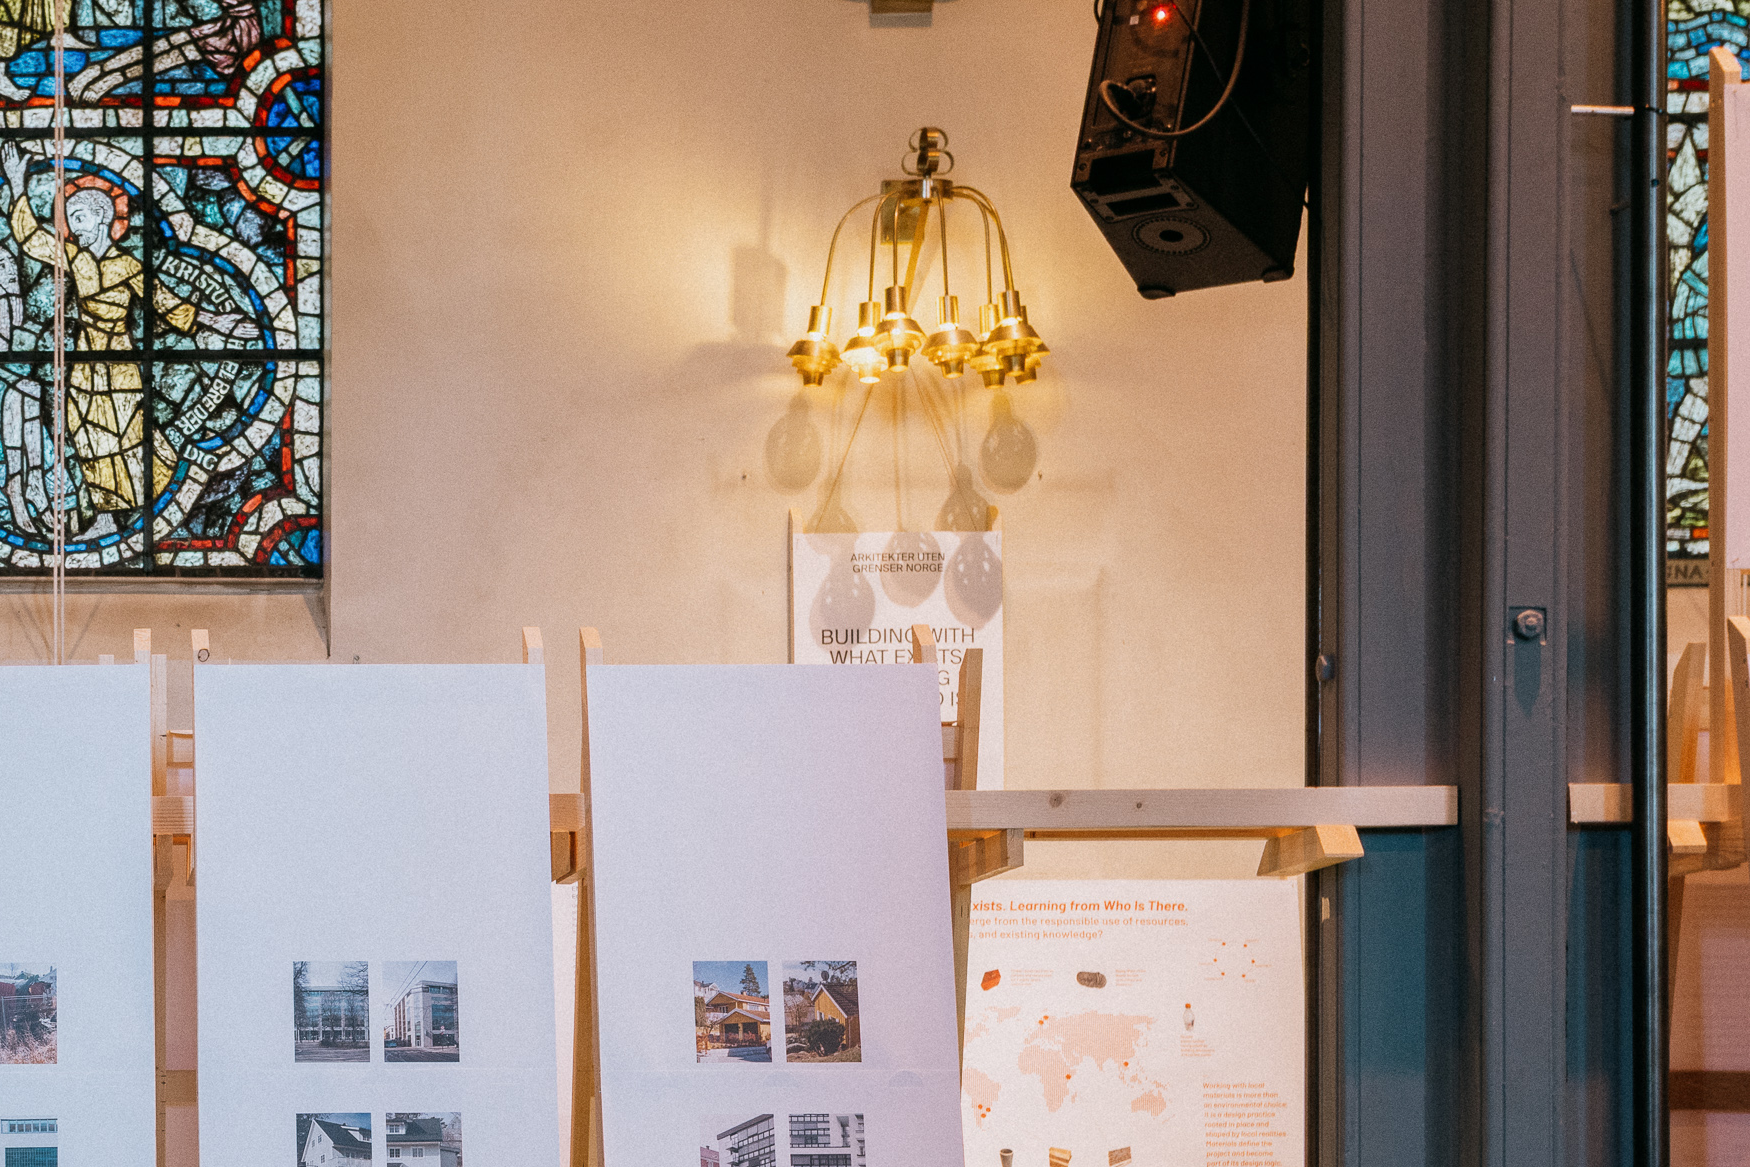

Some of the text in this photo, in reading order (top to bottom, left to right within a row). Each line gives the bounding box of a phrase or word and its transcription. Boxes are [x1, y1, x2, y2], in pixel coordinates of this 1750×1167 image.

[161, 256, 236, 313] KRISTUS
[851, 552, 945, 562] ARKITEKTER UTEN
[853, 563, 943, 573] GRENSER NORGE
[830, 649, 962, 664] WHAT EXTS
[972, 901, 1188, 913] xists. Learning from Who Is There.
[994, 917, 1018, 925] from
[1021, 917, 1037, 925] the
[1040, 917, 1099, 927] responsible
[1122, 917, 1133, 925] of
[978, 930, 997, 938] and
[1000, 930, 1040, 940] existing
[1043, 930, 1103, 940] knowledge?
